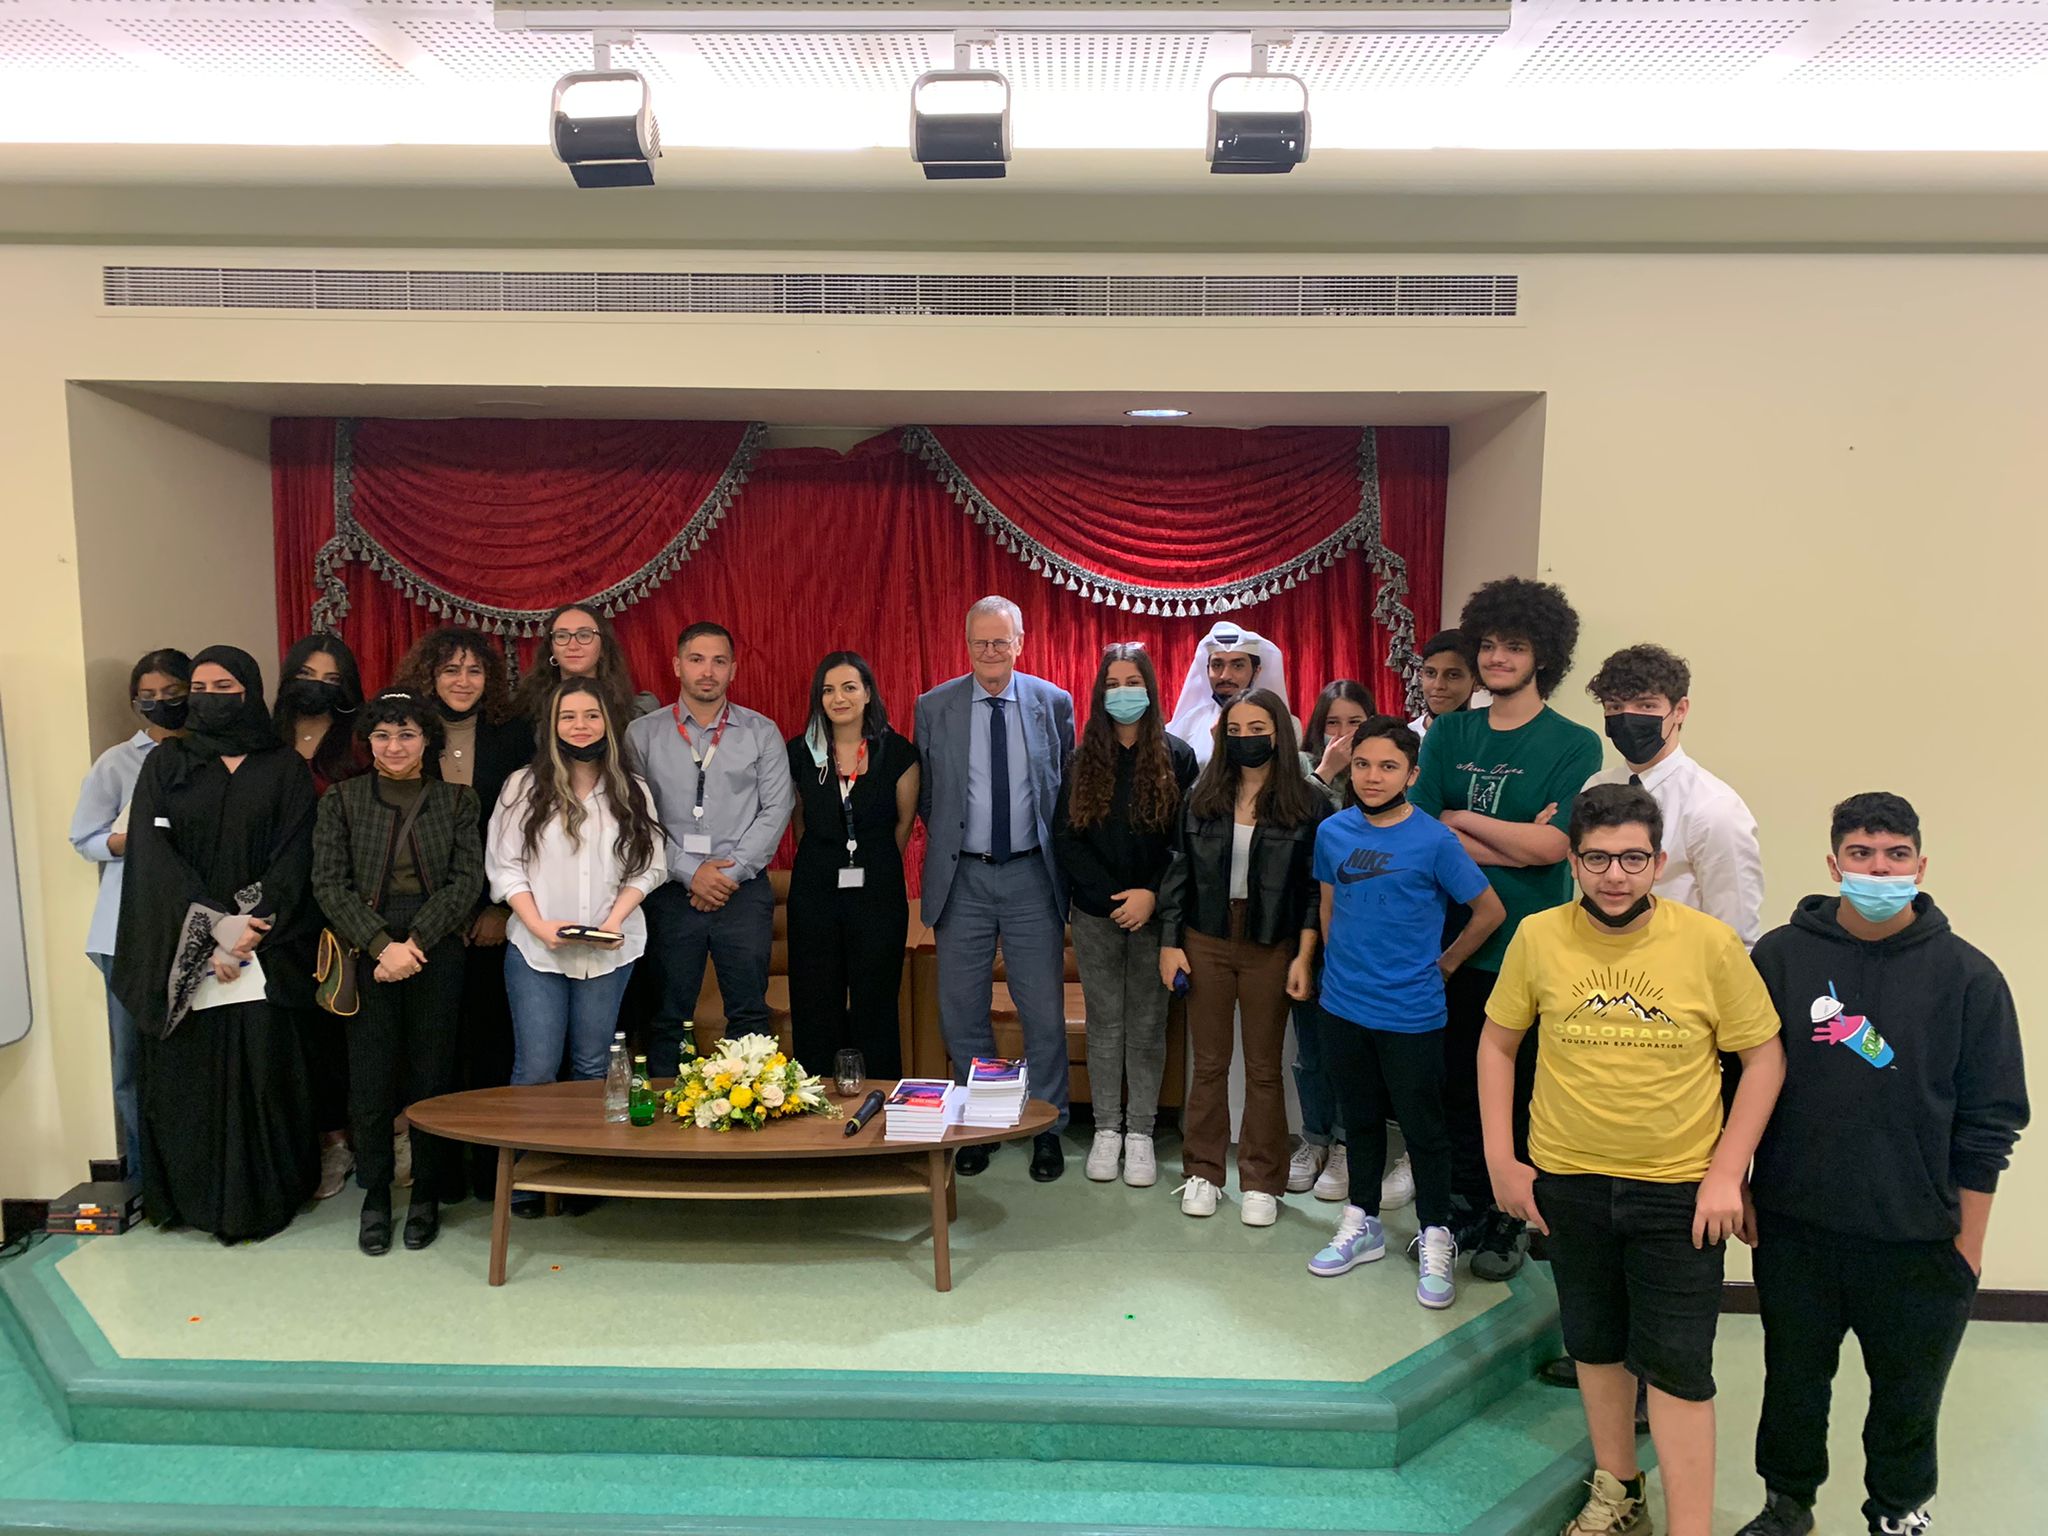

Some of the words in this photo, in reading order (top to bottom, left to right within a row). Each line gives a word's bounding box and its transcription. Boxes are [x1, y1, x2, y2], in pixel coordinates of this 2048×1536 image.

[1345, 847, 1394, 872] NIKE
[1553, 1023, 1692, 1040] COLORADO
[1561, 1038, 1609, 1046] MOUNTAIN
[1614, 1041, 1684, 1049] EXPLORATION
